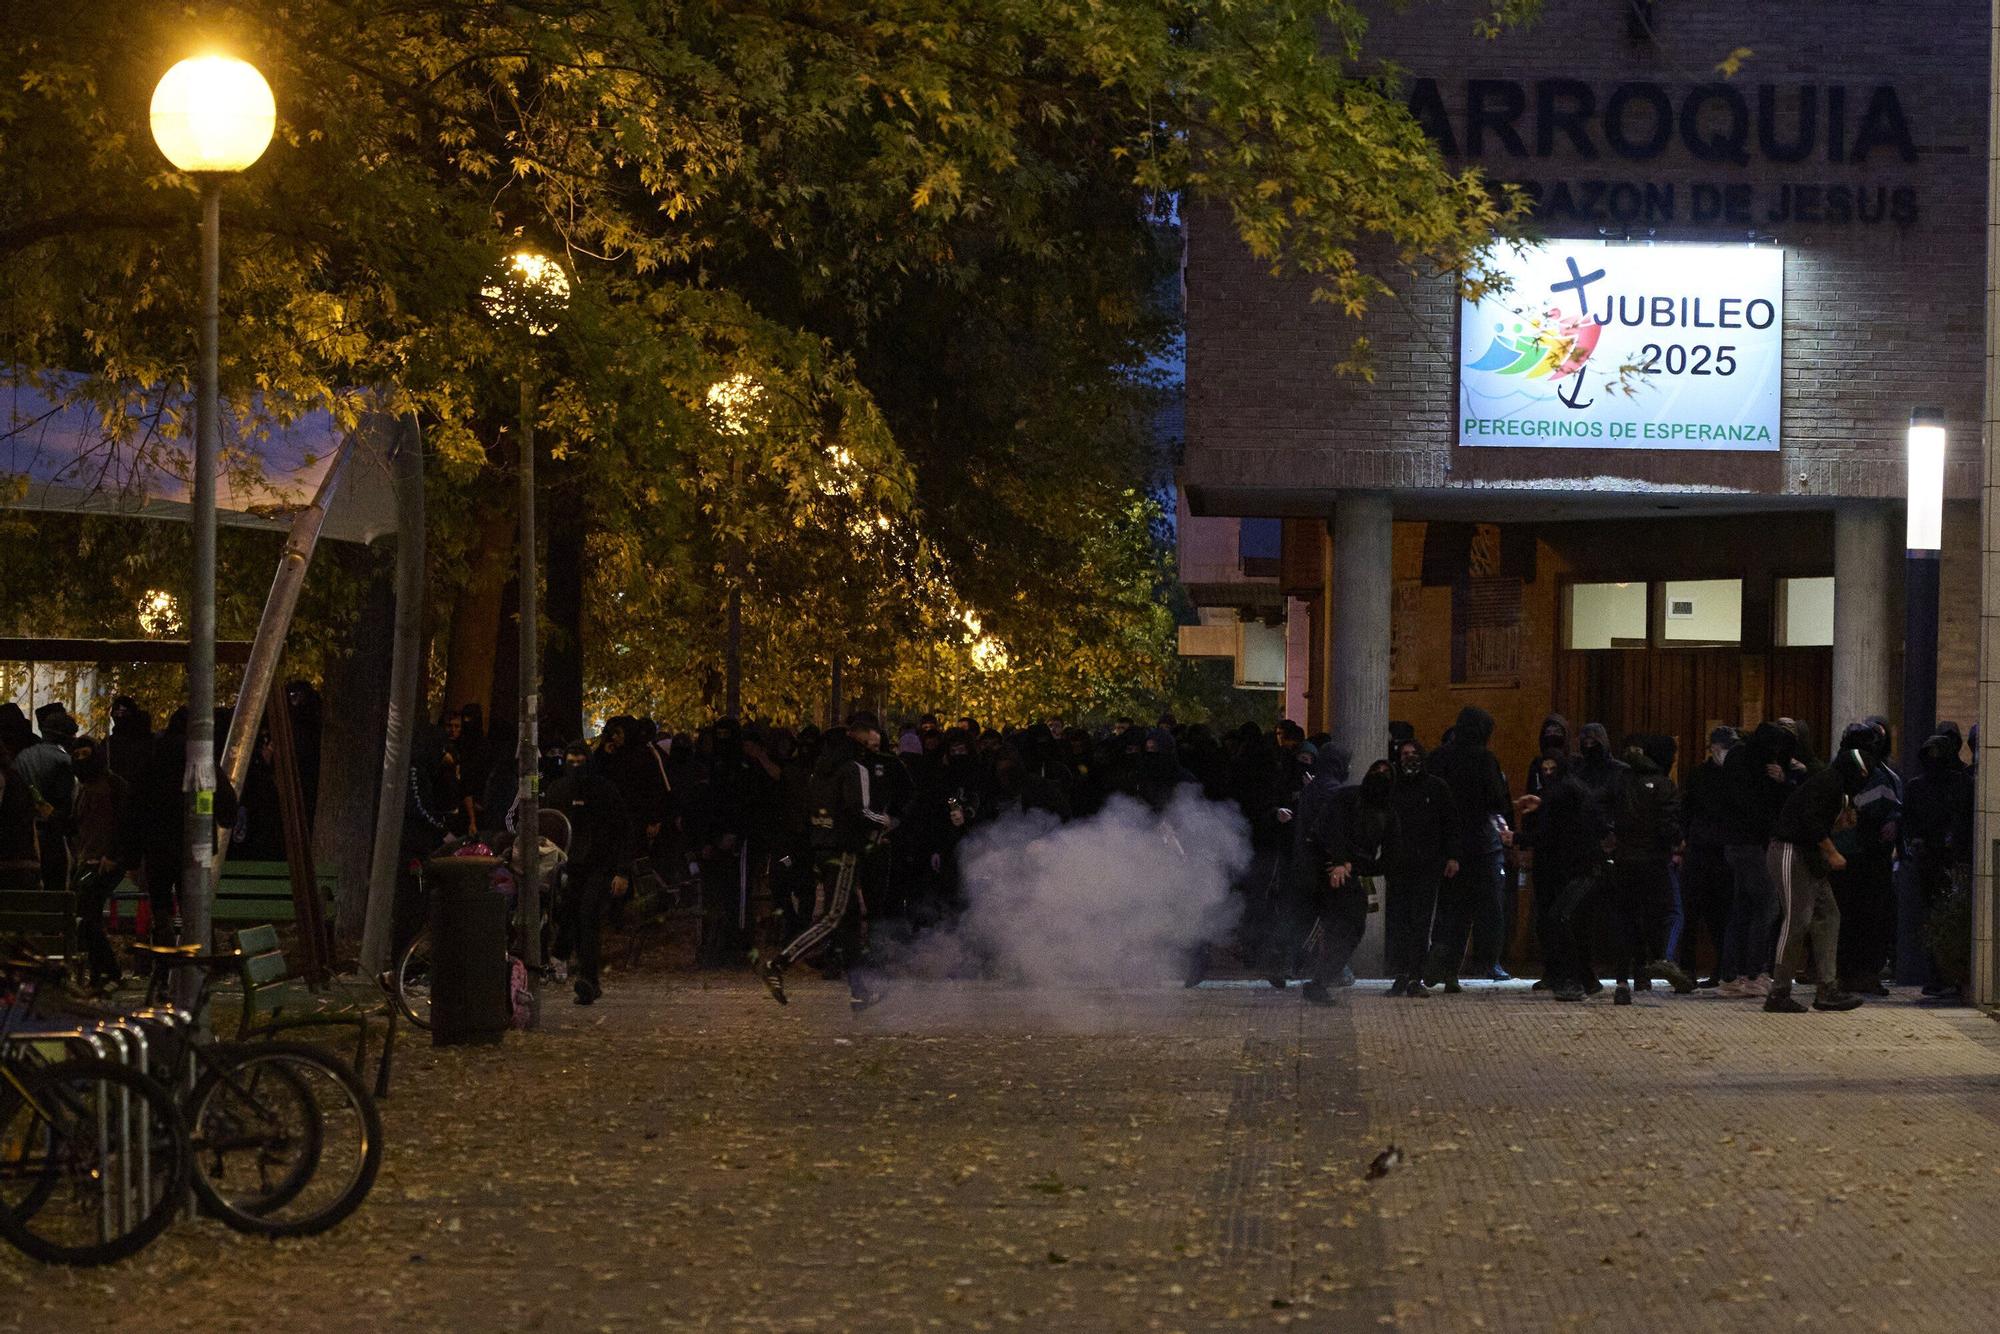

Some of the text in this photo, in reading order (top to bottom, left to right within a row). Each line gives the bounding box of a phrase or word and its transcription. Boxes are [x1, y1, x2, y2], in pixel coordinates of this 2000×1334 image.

[1408, 77, 1918, 166] ARROQUIA
[1692, 183, 1752, 223] DE
[1593, 295, 1775, 330] JUBILEO
[1641, 344, 1736, 376] 2025
[1464, 418, 1770, 442] PEREGRINOS DE ESPERANZA
